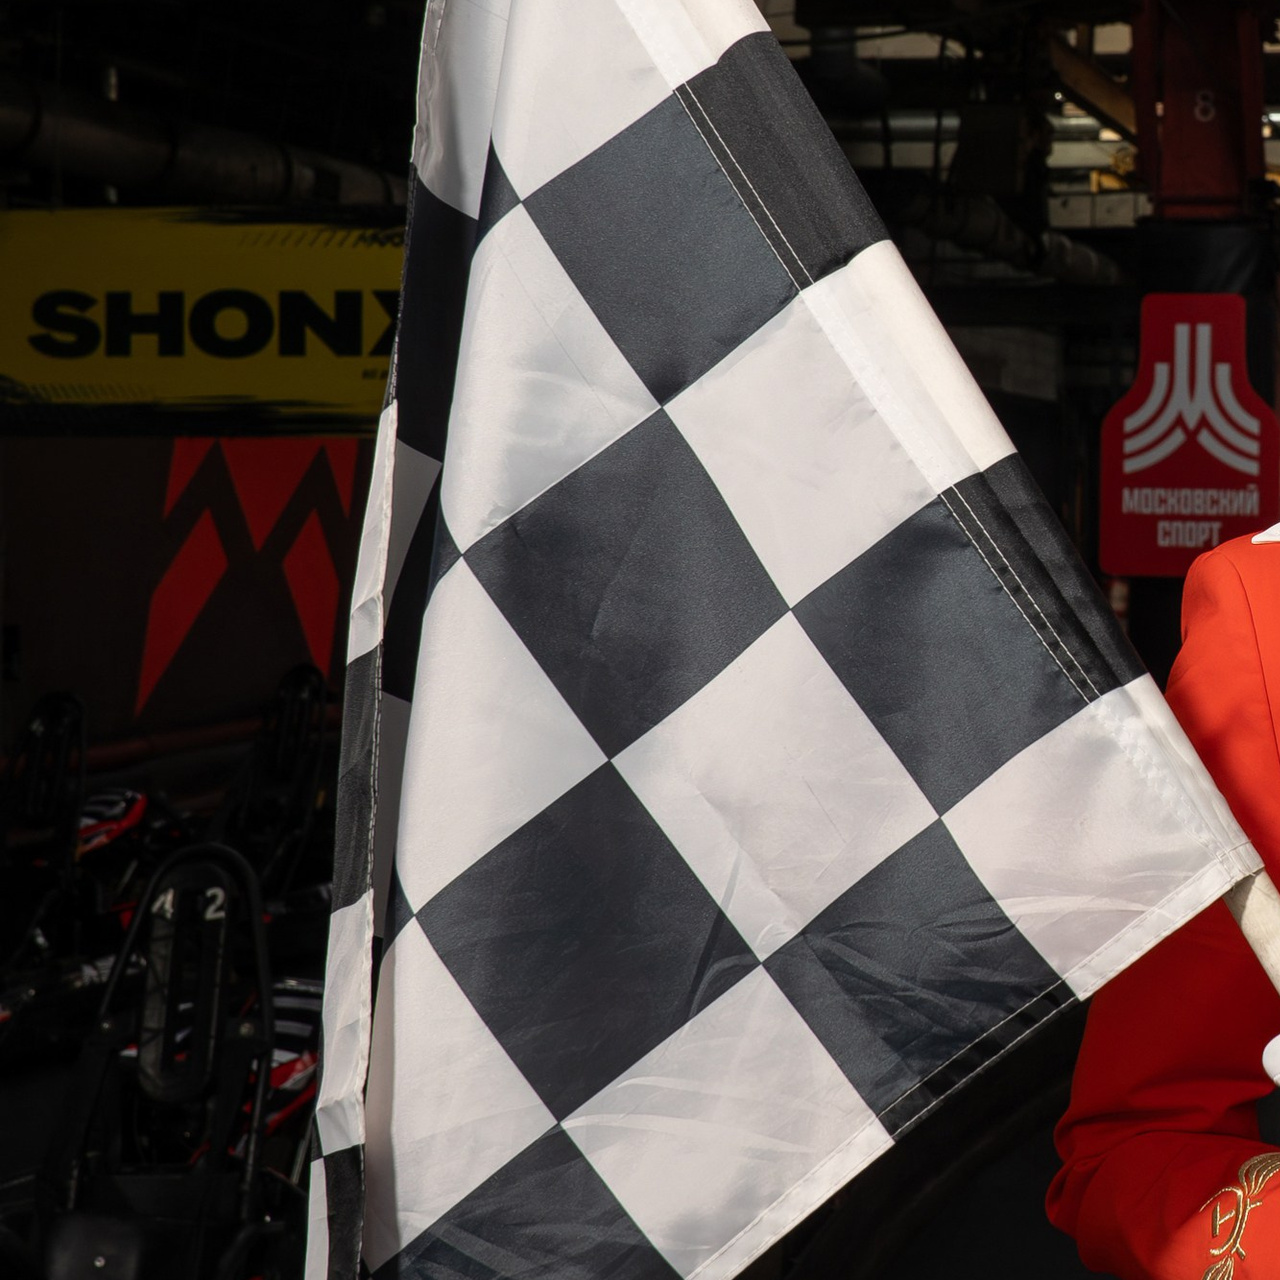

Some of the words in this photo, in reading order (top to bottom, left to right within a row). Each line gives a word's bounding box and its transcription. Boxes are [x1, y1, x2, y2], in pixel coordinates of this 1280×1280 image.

[1194, 89, 1217, 123] 8
[1121, 483, 1261, 517] МОСКОВСКИЙ
[1156, 520, 1224, 548] СПОРТ
